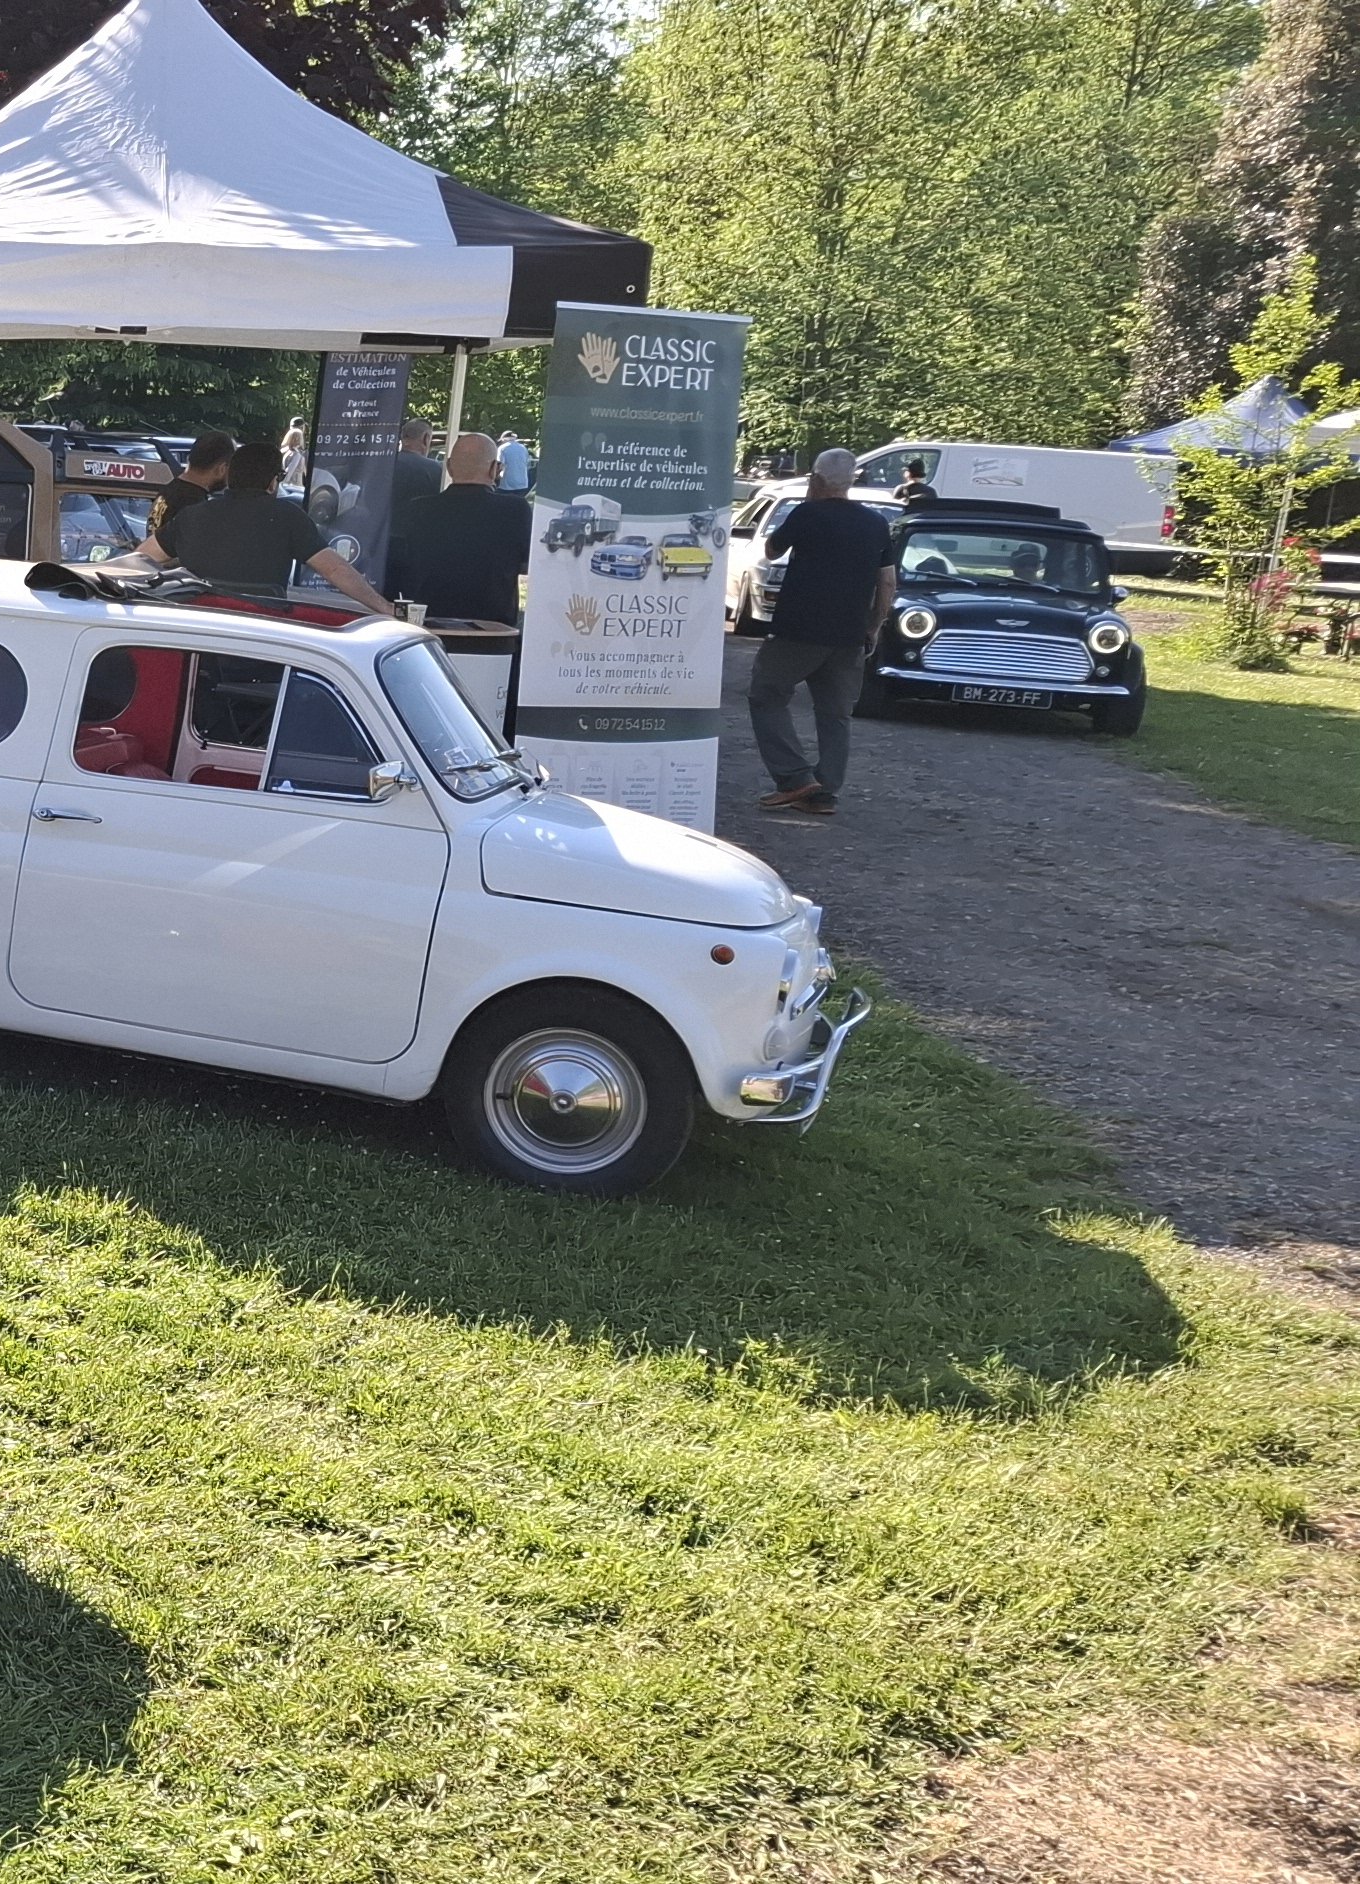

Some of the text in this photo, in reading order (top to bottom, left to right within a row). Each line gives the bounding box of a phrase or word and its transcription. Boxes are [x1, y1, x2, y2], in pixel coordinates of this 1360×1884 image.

[625, 334, 717, 364] CLASSIC
[330, 353, 407, 363] ESTIMATION
[336, 365, 397, 377] de Véhicules
[621, 363, 714, 391] EXPERT
[332, 379, 397, 390] de Collection
[347, 399, 377, 408] Partout
[341, 409, 380, 419] en France
[590, 406, 704, 425] www.classicexpert.fr
[316, 434, 396, 444] 09 72 54 15 12
[600, 441, 688, 458] La référence de
[107, 464, 145, 479] AUTO
[578, 456, 708, 475] l'expertise de véhicules
[577, 475, 706, 491] anciens et de collection.
[605, 593, 689, 615] CLASSIC
[603, 617, 688, 639] EXPERT
[569, 649, 684, 665] Vous accompagner à
[558, 666, 695, 680] tous les moments de vie
[575, 682, 588, 694] de
[592, 683, 621, 695] votre
[963, 686, 1041, 705] BM-273-FF
